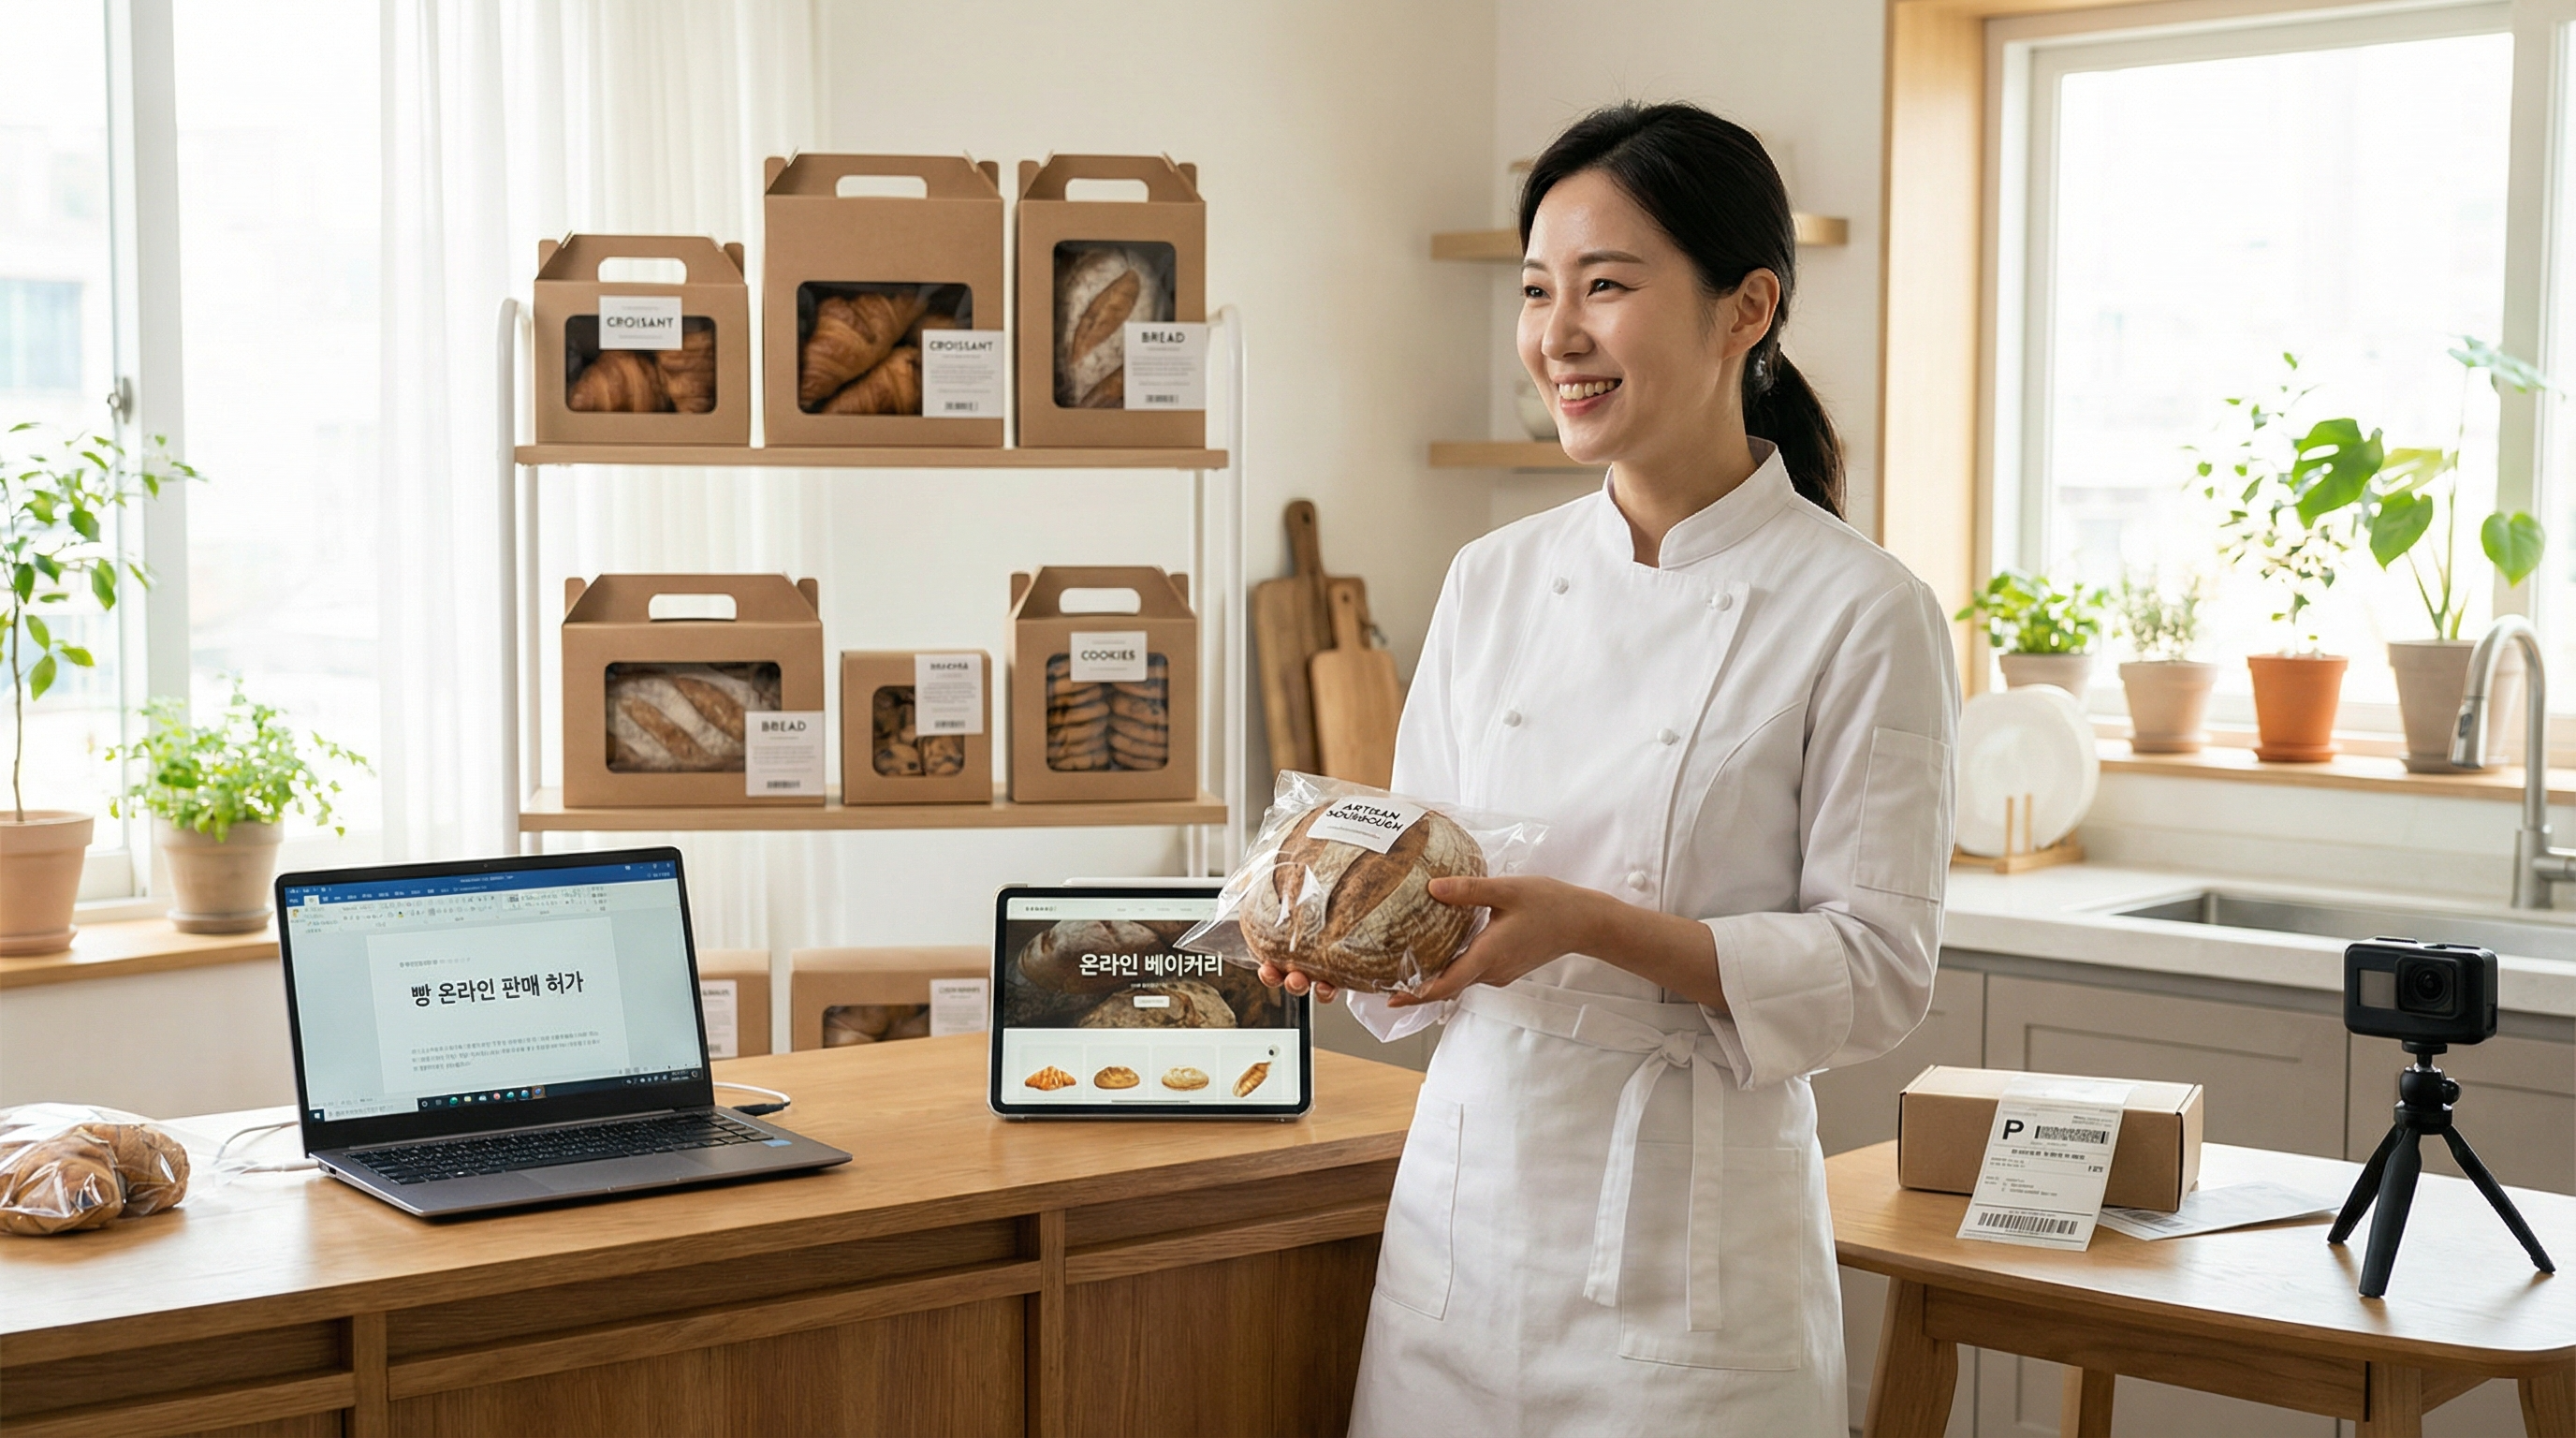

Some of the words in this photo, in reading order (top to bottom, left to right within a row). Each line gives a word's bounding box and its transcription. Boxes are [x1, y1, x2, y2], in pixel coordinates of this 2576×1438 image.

[1141, 331, 1186, 344] BREAD
[1081, 650, 1135, 661] COOKIES
[761, 720, 807, 732] BREAD
[1079, 953, 1138, 976] 온라인
[1145, 952, 1222, 976] 베이커리
[411, 983, 432, 1007] 빵
[438, 977, 496, 1005] 온라인
[501, 974, 540, 999] 판매
[545, 971, 584, 994] 허가
[2002, 1119, 2025, 1140] P
